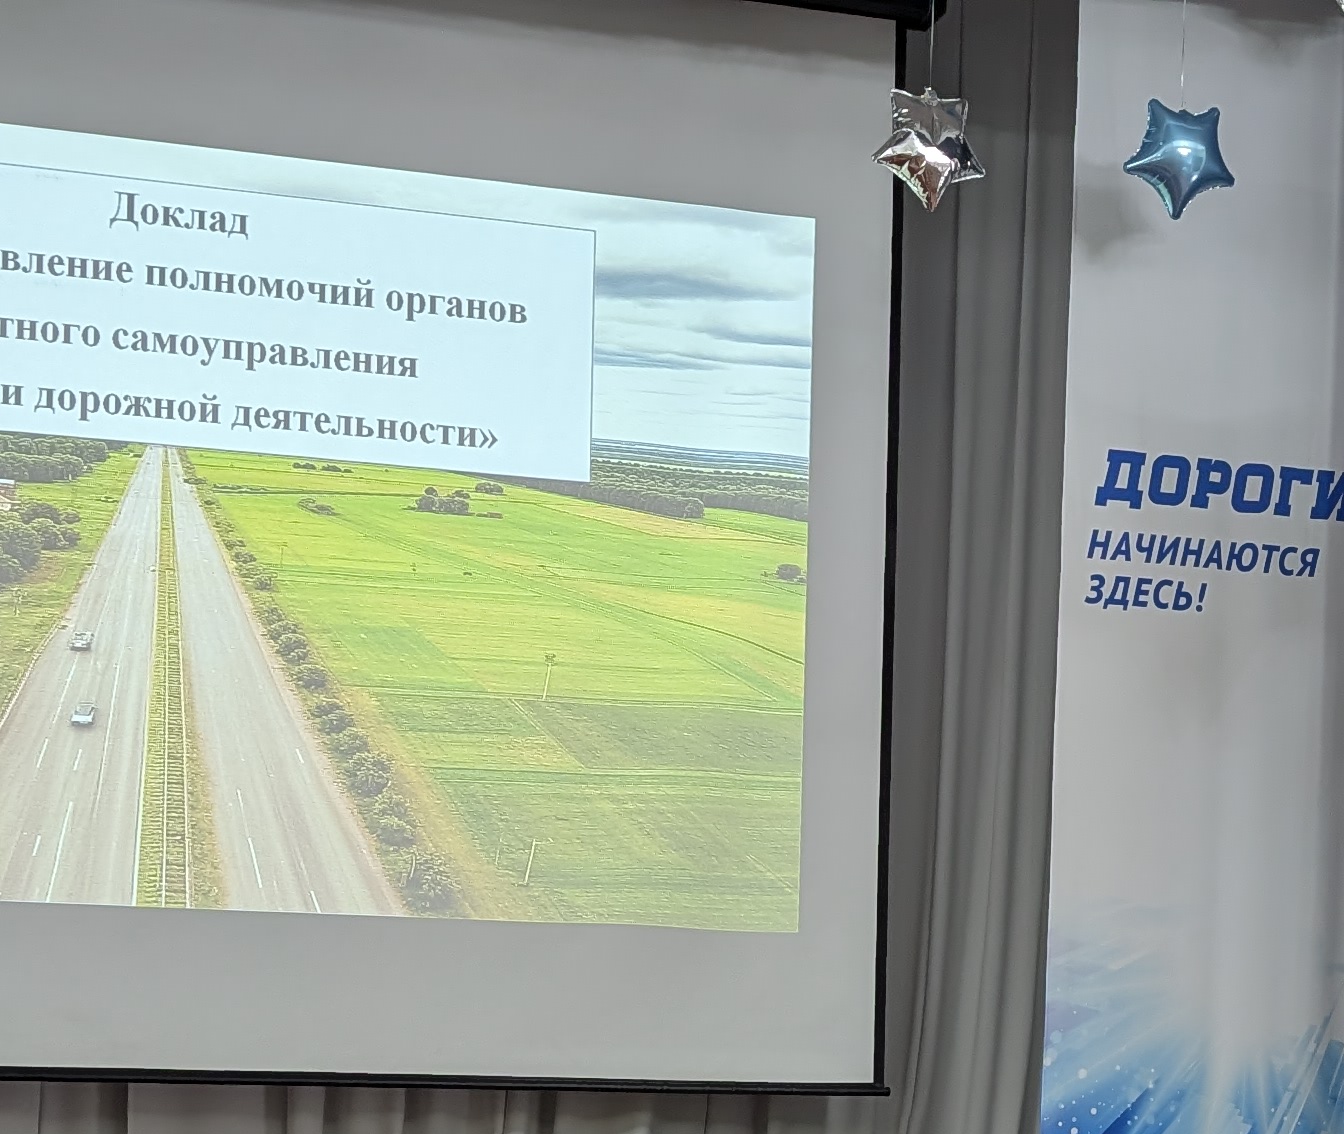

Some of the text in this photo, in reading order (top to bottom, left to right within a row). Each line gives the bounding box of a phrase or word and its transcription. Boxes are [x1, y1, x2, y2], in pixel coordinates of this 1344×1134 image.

[109, 190, 249, 239] Доклад
[144, 263, 376, 309] полномочий
[385, 289, 528, 325] органов
[112, 326, 419, 378] самоуправления
[34, 386, 221, 425] дорожной
[231, 404, 498, 449] деятельности»
[1087, 529, 1320, 578] НАЧИНАЮТСЯ
[1084, 574, 1208, 613] ЗДЕСЬ!
